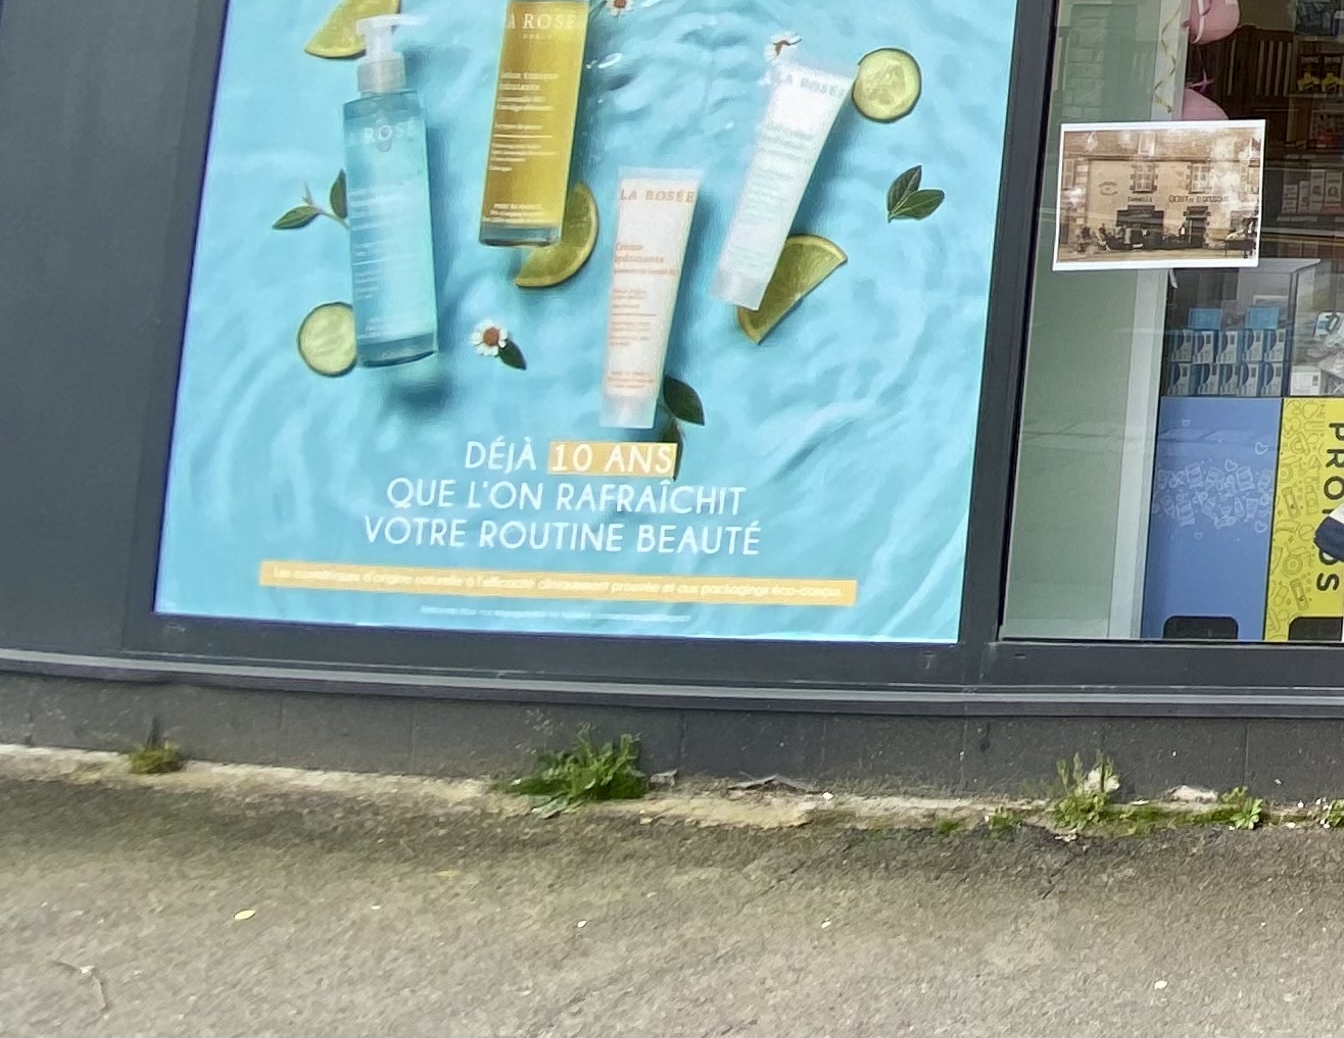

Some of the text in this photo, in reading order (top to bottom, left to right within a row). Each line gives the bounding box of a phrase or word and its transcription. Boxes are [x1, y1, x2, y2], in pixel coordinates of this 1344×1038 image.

[620, 188, 638, 202] LA
[464, 436, 672, 476] DÉJÀ 10 ANS
[387, 477, 747, 515] QUE L'ON RAFRAÎCHIT
[364, 515, 761, 556] VOTRE ROUTINE BEAUTÉ
